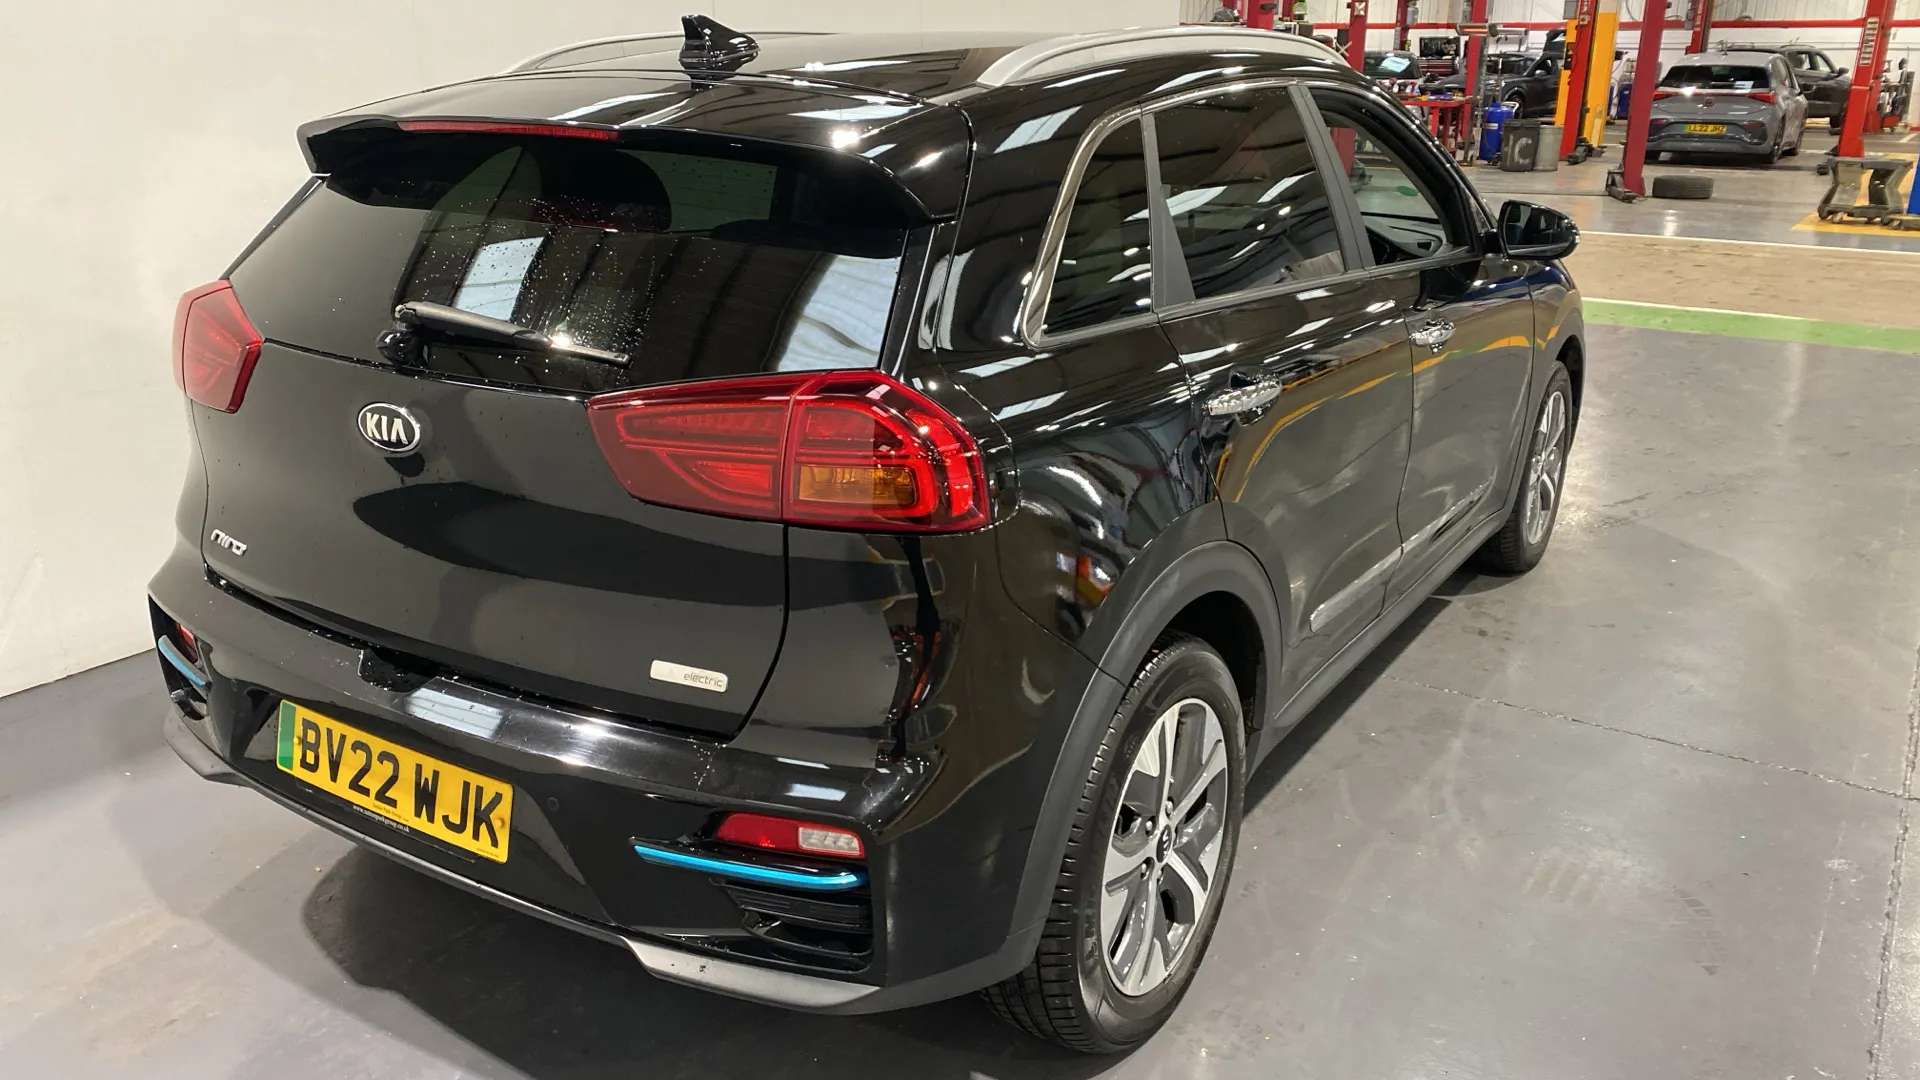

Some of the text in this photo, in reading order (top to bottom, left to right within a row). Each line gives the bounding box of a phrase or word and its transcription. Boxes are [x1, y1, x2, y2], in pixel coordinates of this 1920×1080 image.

[366, 412, 409, 445] KIA
[683, 671, 724, 688] electric
[299, 717, 503, 848] BV22 WJK
